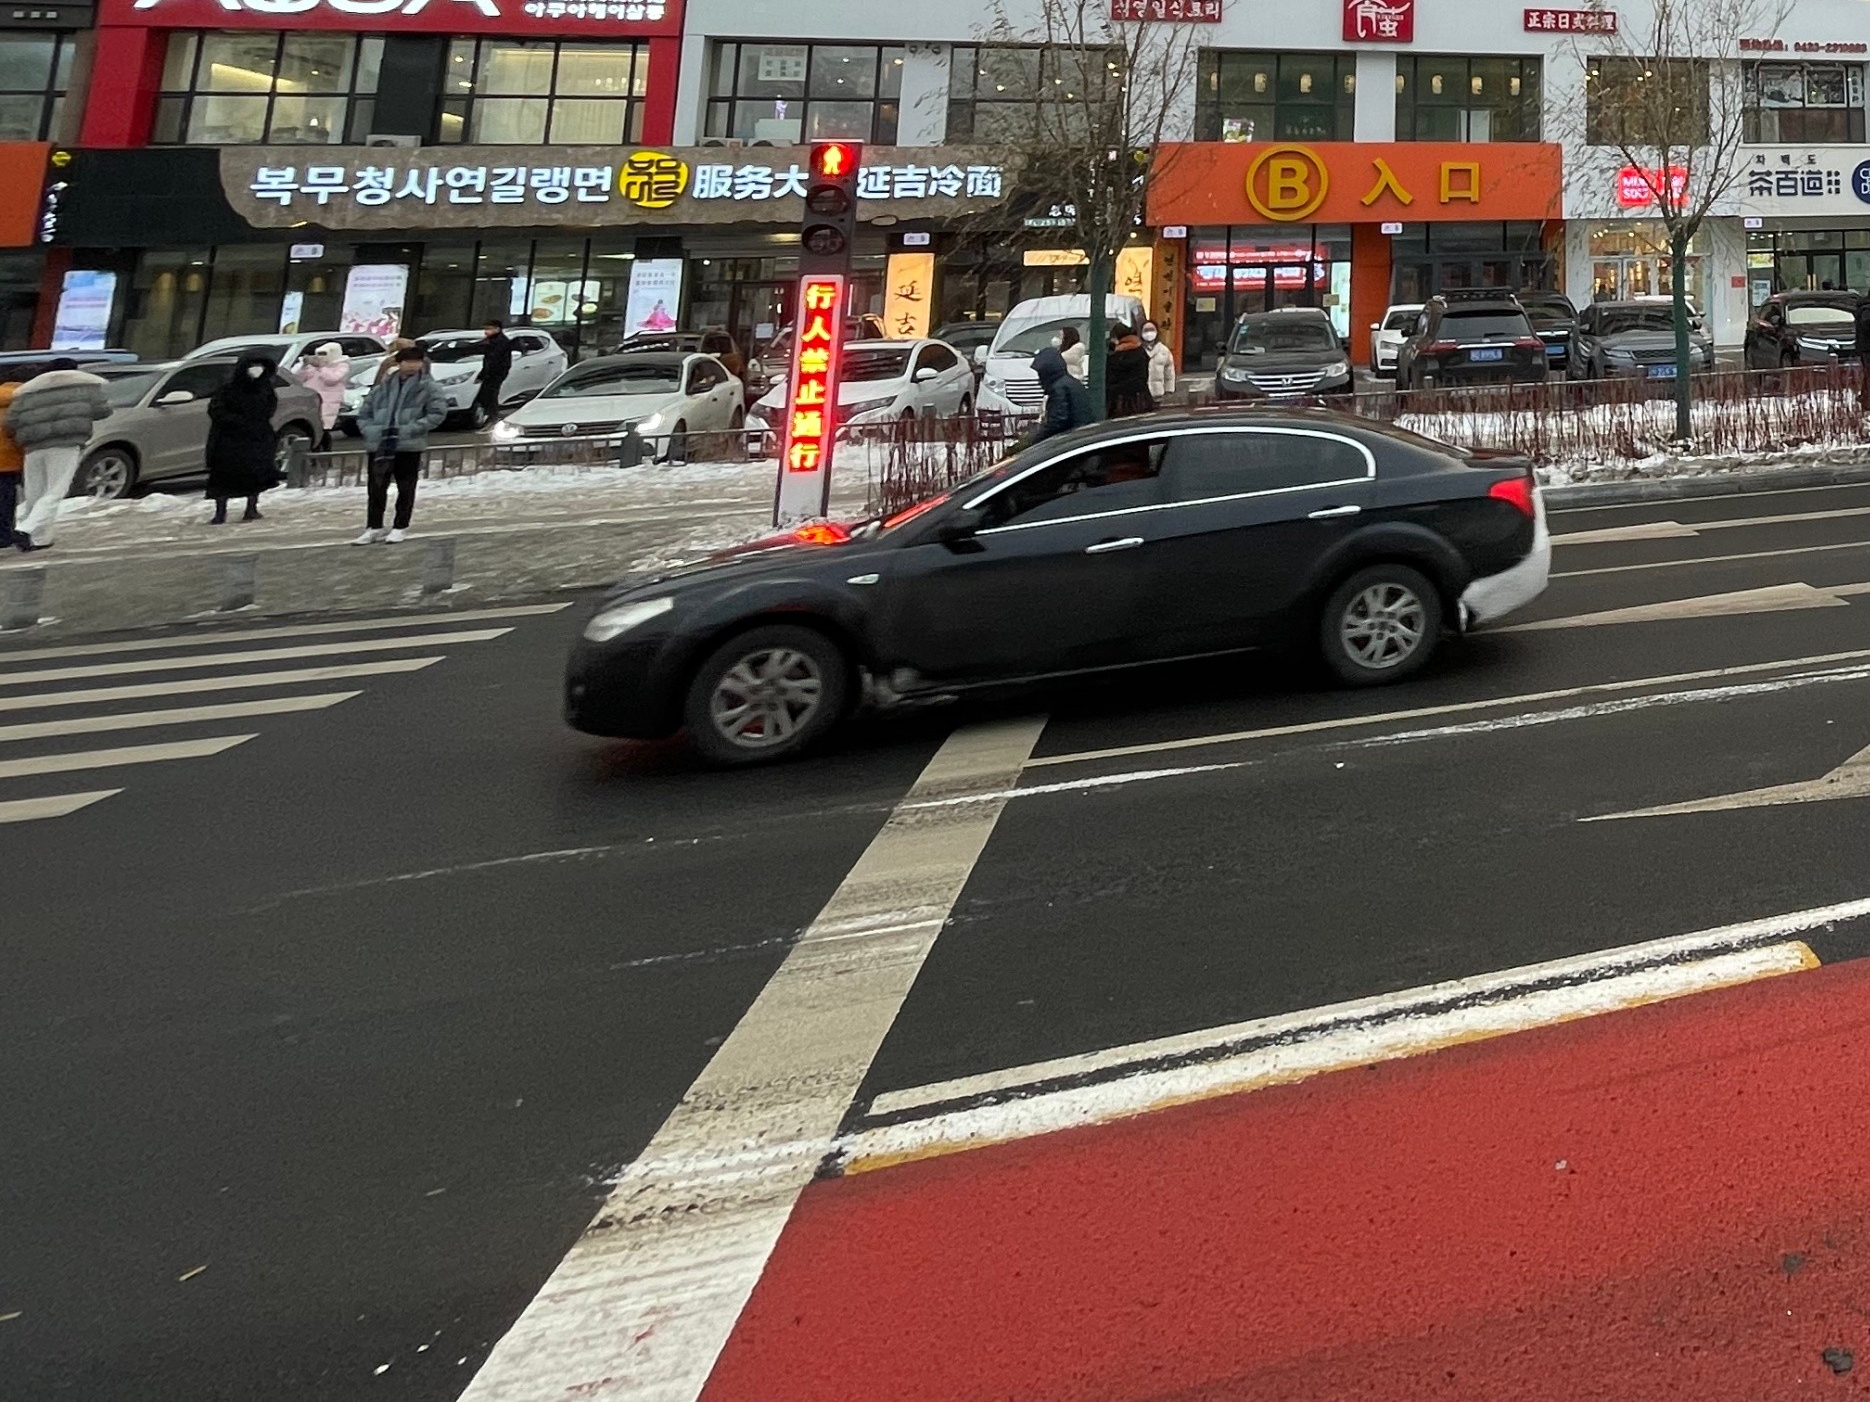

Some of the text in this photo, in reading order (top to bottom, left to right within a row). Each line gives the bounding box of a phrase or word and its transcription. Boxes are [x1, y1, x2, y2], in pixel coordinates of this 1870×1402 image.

[1526, 10, 1616, 32] 正宗日式料理
[250, 165, 613, 206] 복무청사연길랭면
[691, 163, 1003, 200] 服务大延吉冷面
[1361, 157, 1481, 207] 入口
[1750, 169, 1824, 198] 茶百道
[893, 279, 923, 336] 延吉
[788, 284, 836, 469] 行人禁止通行
